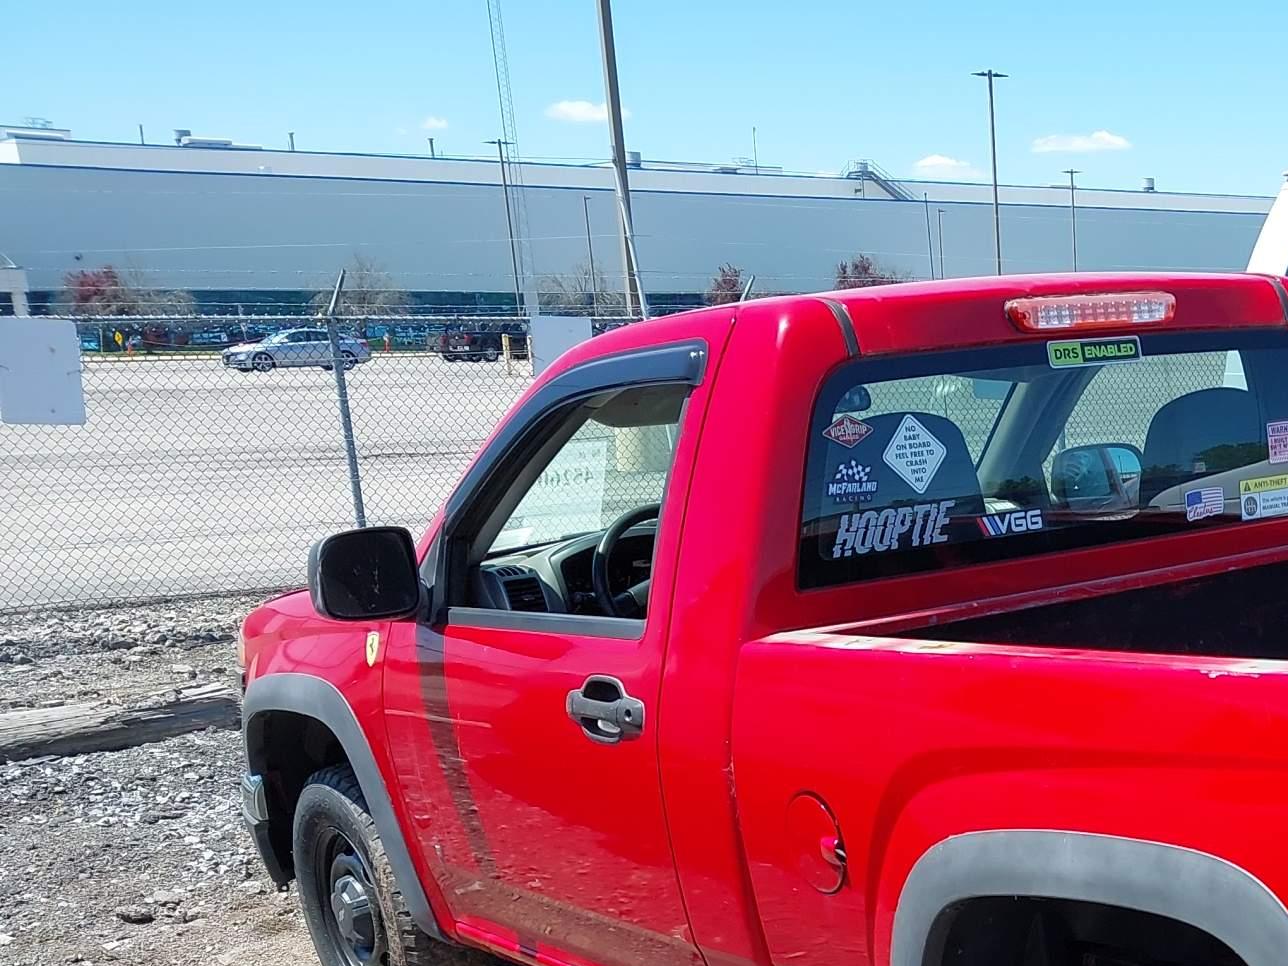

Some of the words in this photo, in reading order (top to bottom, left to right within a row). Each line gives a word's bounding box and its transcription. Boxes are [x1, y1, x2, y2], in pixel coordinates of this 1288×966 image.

[1054, 347, 1080, 360] DRS
[1084, 343, 1136, 358] ENABLED
[904, 425, 916, 433] NO
[895, 443, 907, 451] ON
[908, 441, 931, 450] BOARD
[895, 452, 909, 460] FEEL
[910, 450, 924, 458] FREE
[905, 459, 928, 467] CRASH
[911, 467, 927, 475] INTO
[832, 500, 956, 558] HOOPTIE
